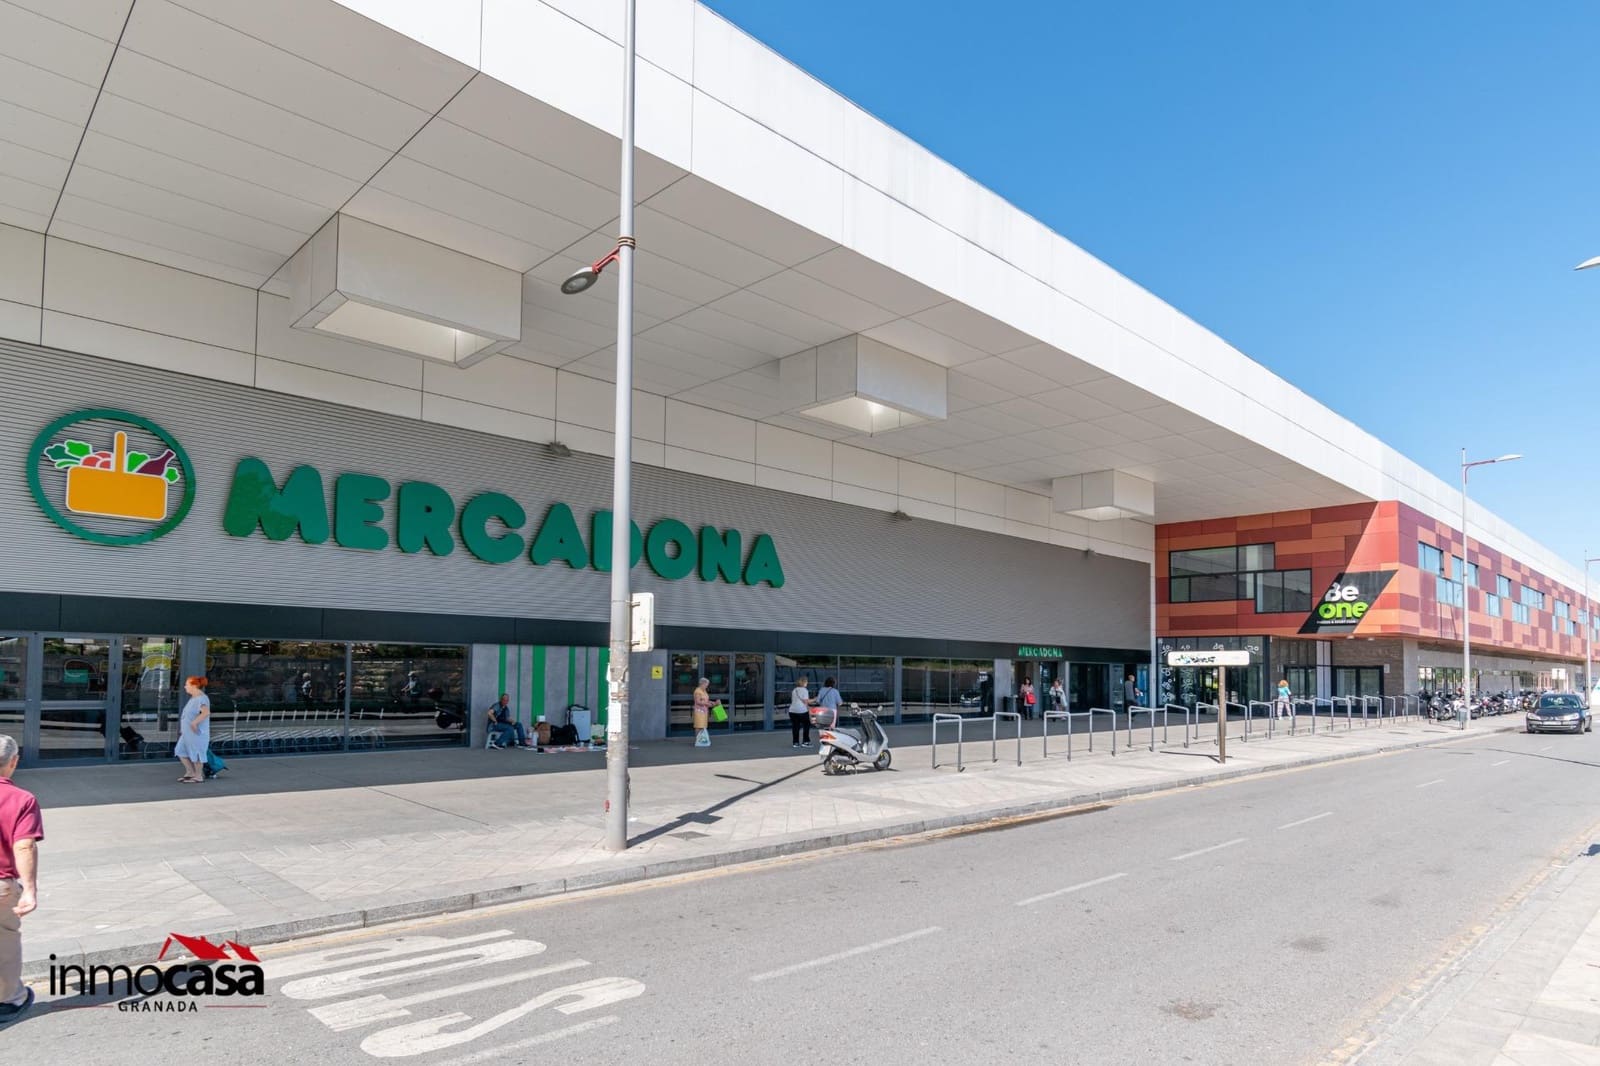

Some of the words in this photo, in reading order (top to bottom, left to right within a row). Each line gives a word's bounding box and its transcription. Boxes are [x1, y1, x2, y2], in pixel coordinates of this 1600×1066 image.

[223, 457, 785, 588] MERCADONA
[1318, 601, 1369, 619] one
[1018, 645, 1063, 658] MERCADONA
